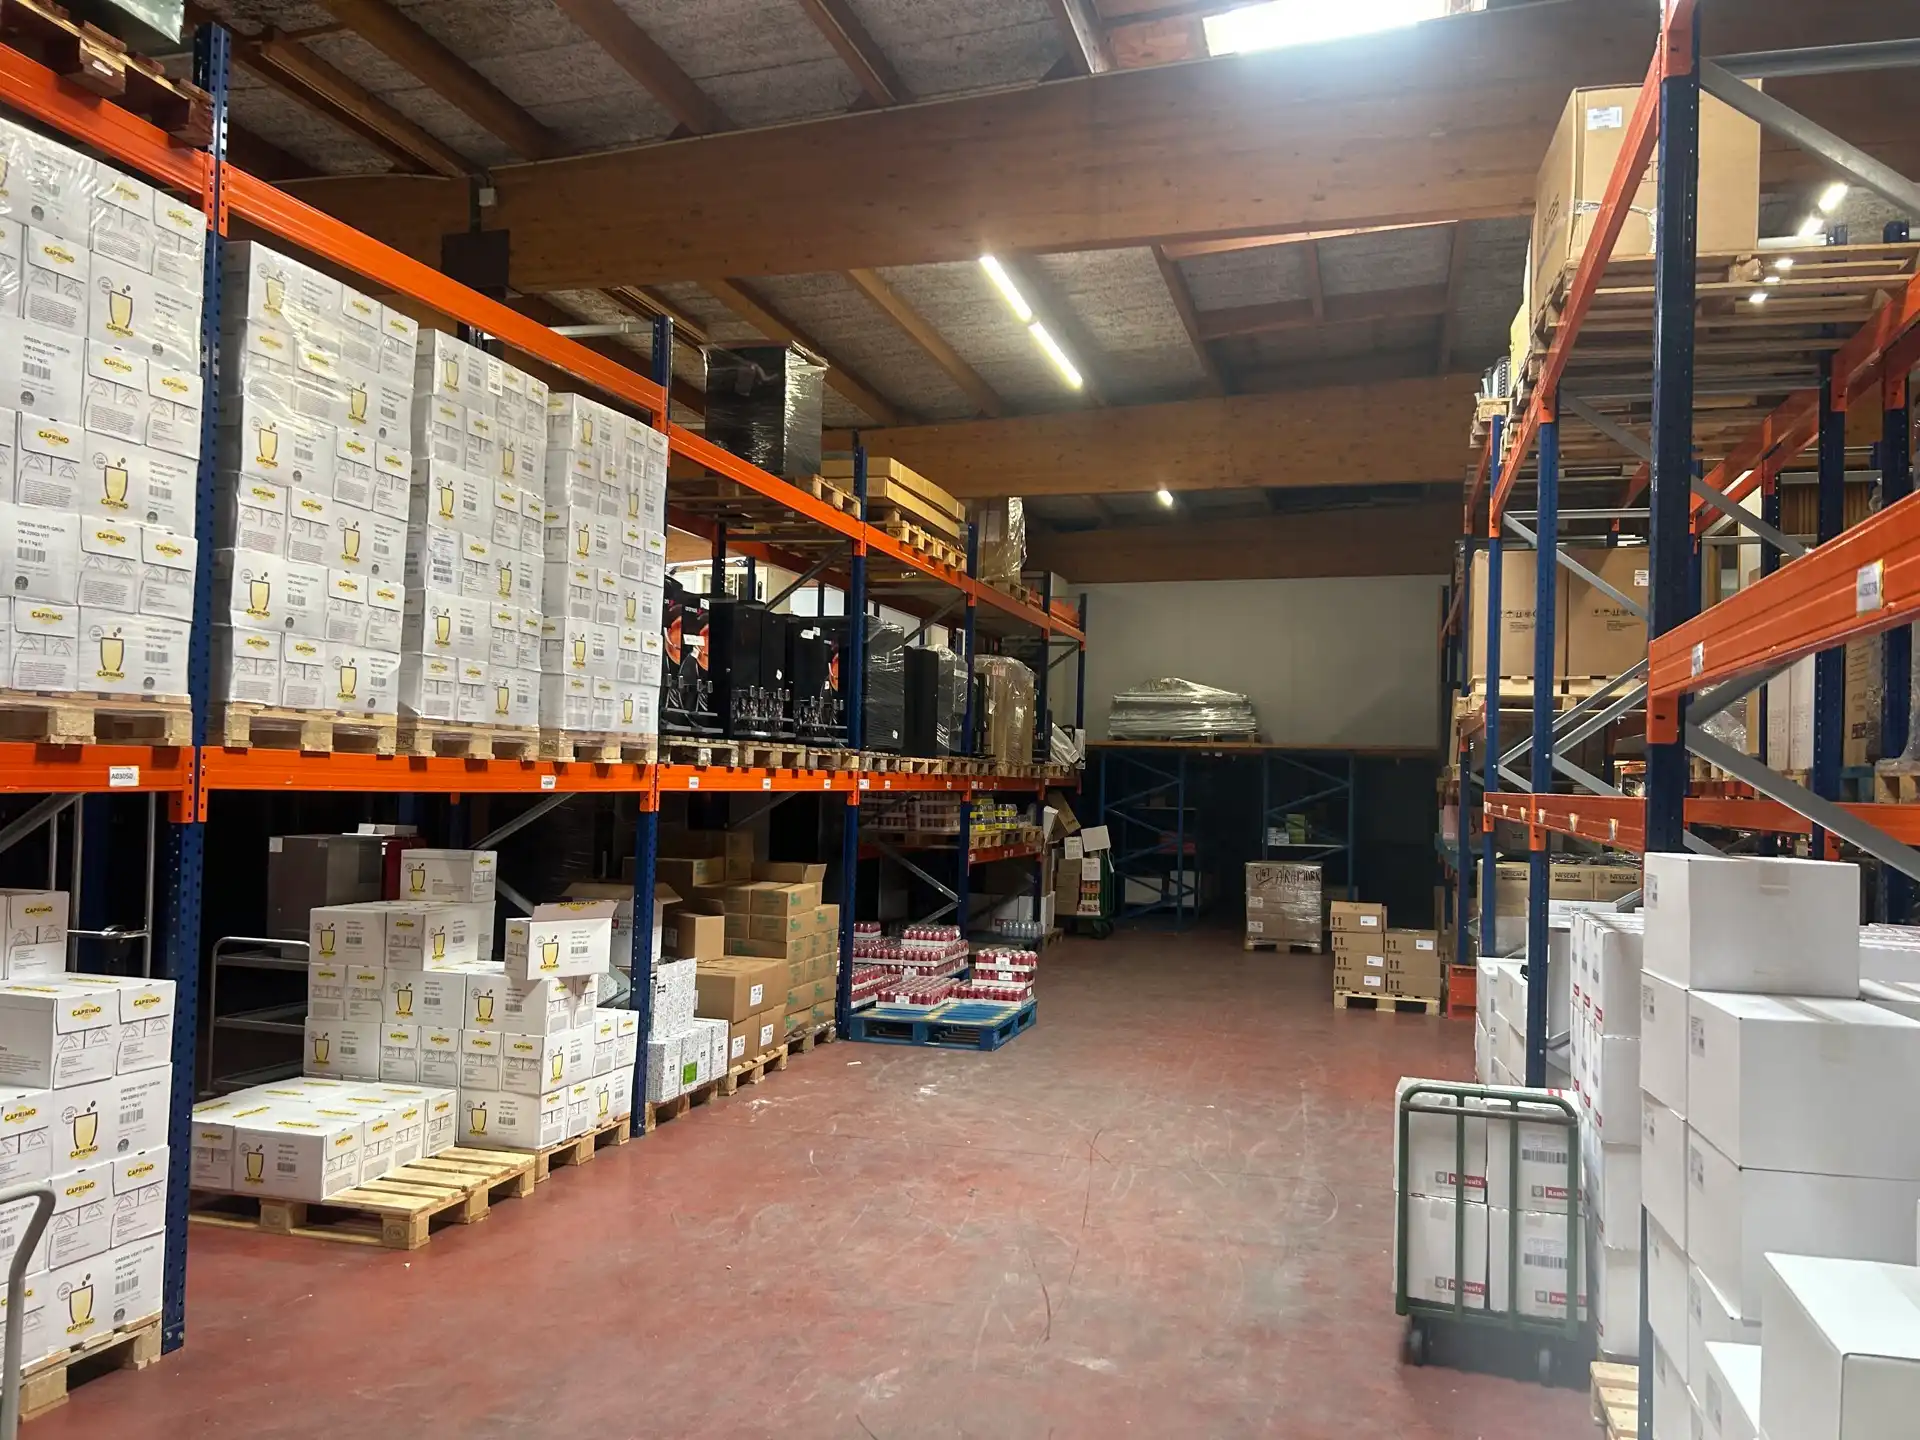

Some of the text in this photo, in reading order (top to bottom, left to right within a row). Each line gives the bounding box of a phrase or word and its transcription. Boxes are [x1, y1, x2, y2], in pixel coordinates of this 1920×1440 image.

[44, 247, 74, 263] CAPRIMO
[106, 322, 134, 337] CAPRIMO
[103, 358, 132, 373] CAPRIMO
[162, 378, 188, 392] CAPRIMO
[38, 430, 69, 444] CAPRIMO
[100, 498, 128, 509] CAPRIMO
[97, 532, 126, 543] CAPRIMO
[155, 544, 182, 555] CAPRIMO
[32, 611, 63, 621] CAPRIMO
[1501, 869, 1526, 877] NESCAFÉ
[1555, 871, 1581, 879] NESCAFÉ
[25, 906, 52, 914] CAPRIMO
[134, 996, 161, 1007] CAPRIMO
[72, 1006, 101, 1017] CAPRIMO
[4, 1109, 36, 1122] CAPRIMO
[70, 1145, 99, 1160] CAPRIMO
[127, 1164, 155, 1178] CAPRIMO
[66, 1181, 95, 1196] CAPRIMO
[66, 1318, 95, 1334] CAPRIMO
